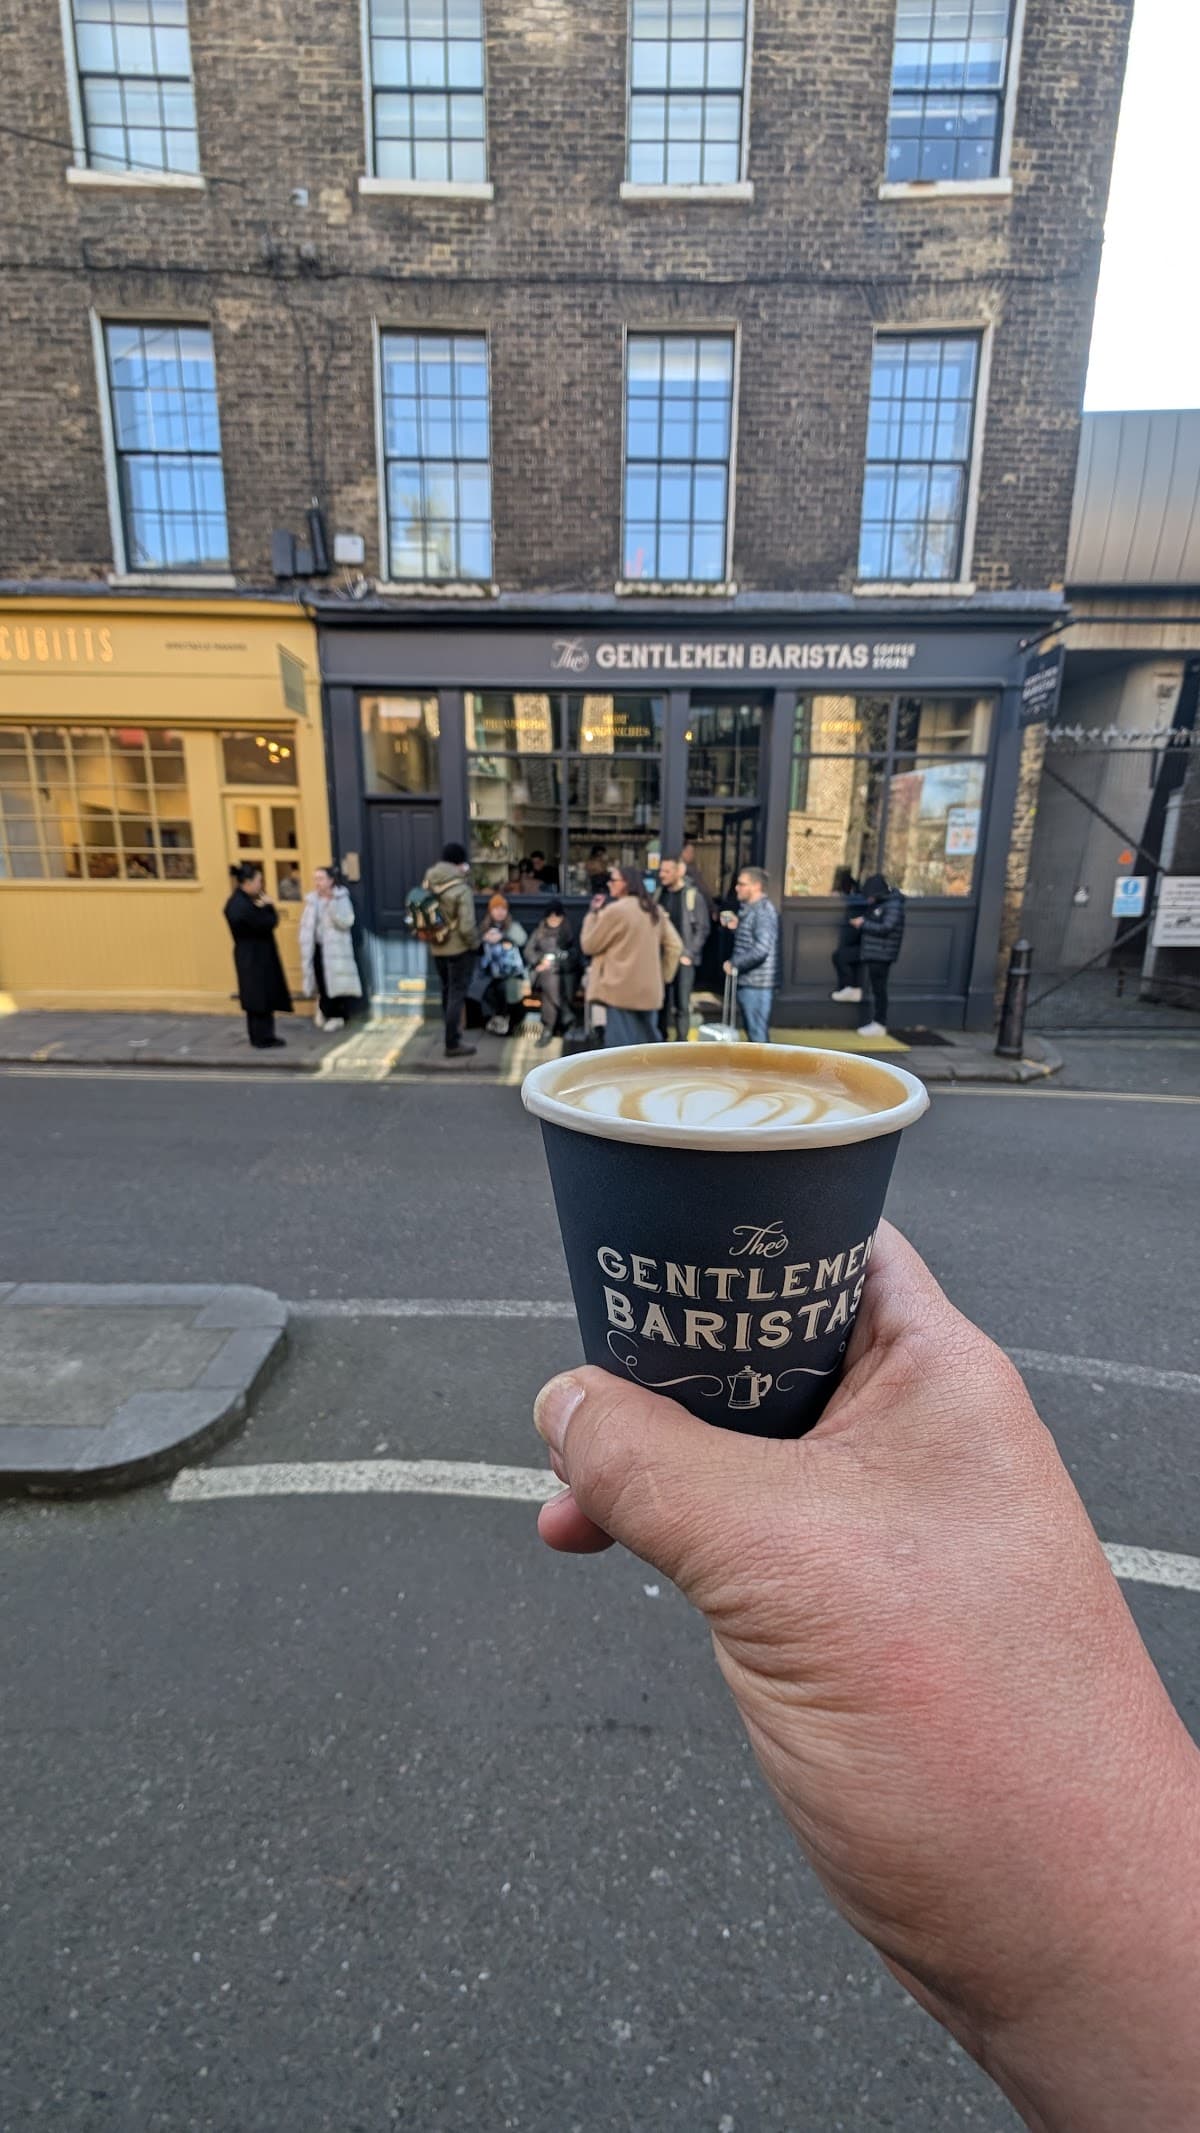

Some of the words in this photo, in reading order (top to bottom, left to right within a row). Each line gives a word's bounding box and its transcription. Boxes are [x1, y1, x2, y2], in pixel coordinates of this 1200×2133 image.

[0, 625, 113, 662] CUBITTS
[551, 637, 590, 673] The
[595, 642, 745, 669] GENTLEMEN
[748, 642, 869, 669] BARISTAS
[728, 1220, 790, 1259] The
[603, 1273, 866, 1352] BARISTAS
